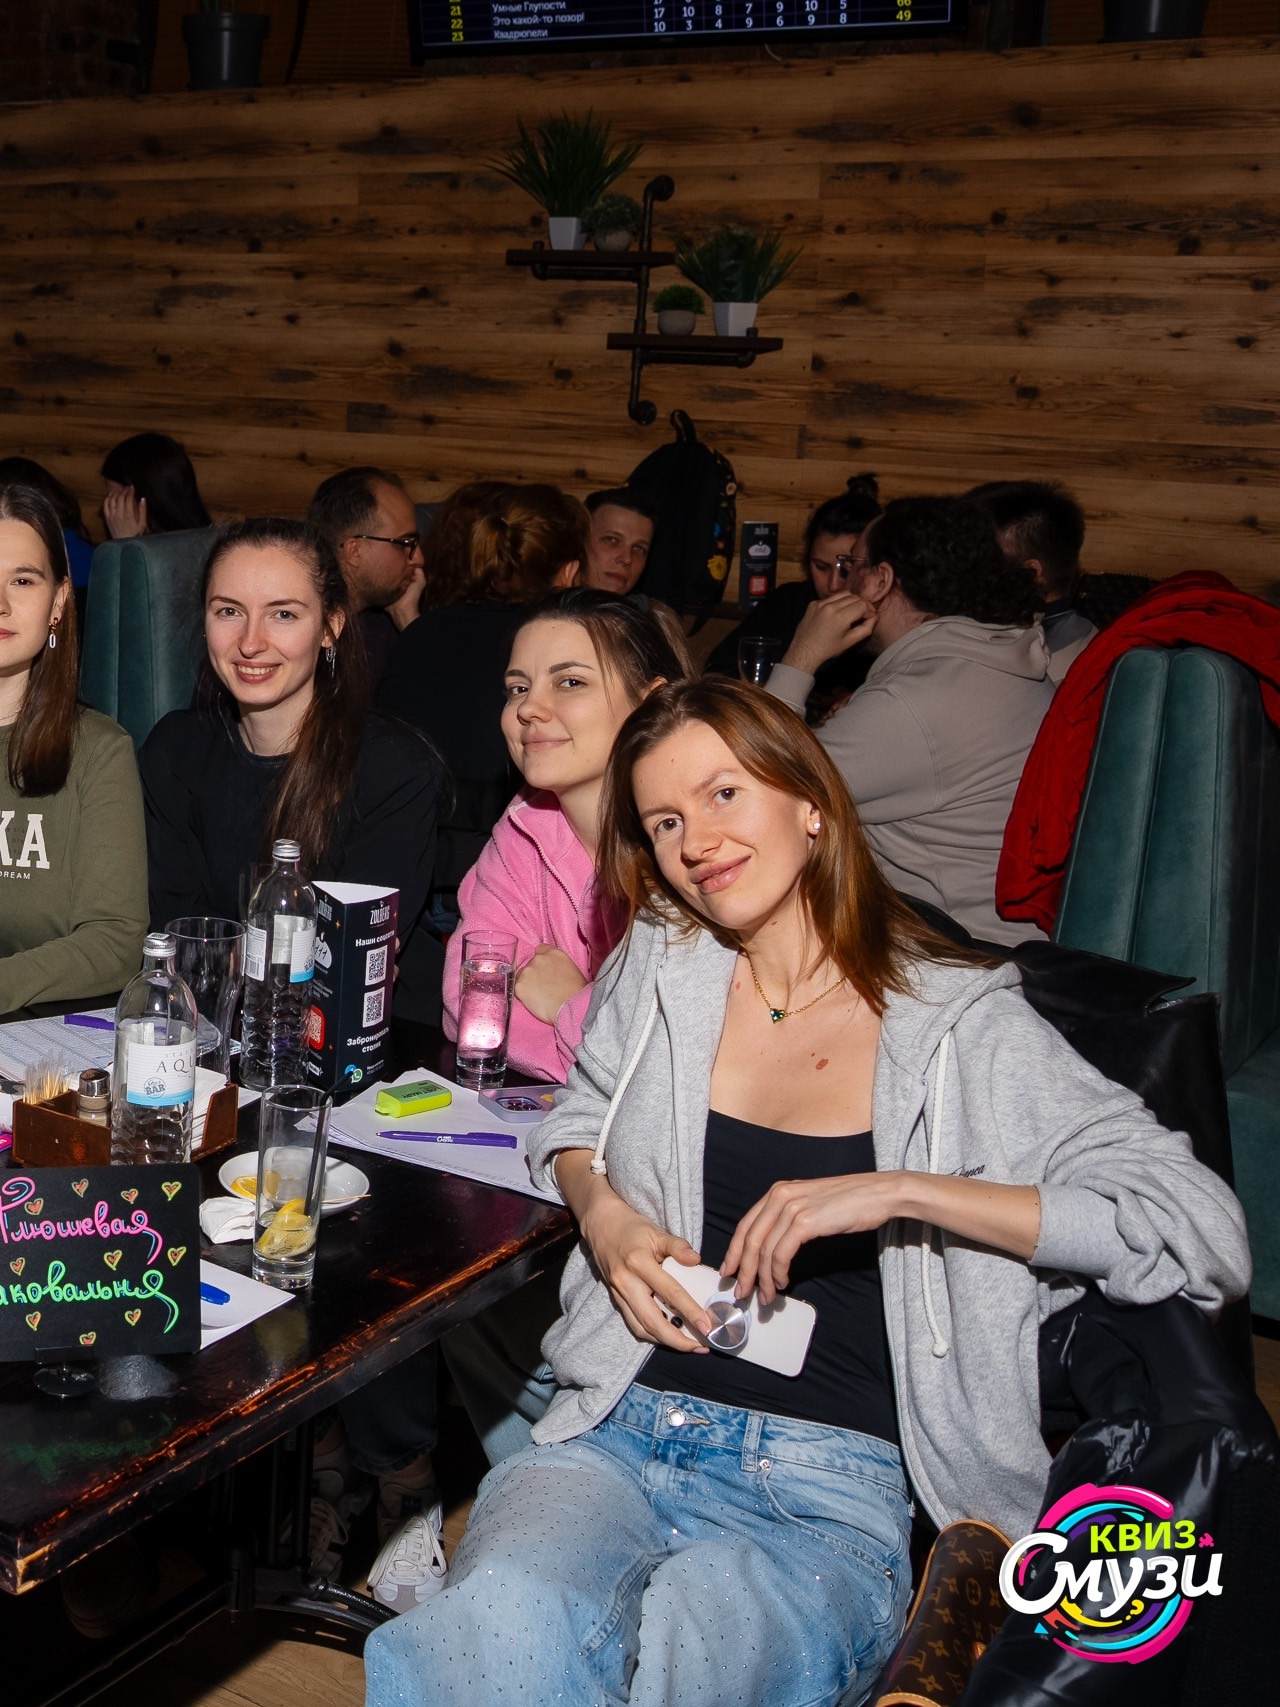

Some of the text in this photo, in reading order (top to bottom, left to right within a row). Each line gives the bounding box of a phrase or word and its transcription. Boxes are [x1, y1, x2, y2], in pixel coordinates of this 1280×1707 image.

[451, 1, 567, 16] 21 Умные Глупости
[451, 19, 463, 29] 22
[493, 16, 511, 26] Это
[512, 14, 553, 25] какой-то
[653, 8, 665, 19] 17
[683, 6, 695, 17] 10
[715, 5, 723, 15] 8
[745, 3, 753, 14] 7
[776, 2, 784, 12] 9
[805, 0, 818, 11] 10
[452, 31, 464, 42] 23
[653, 21, 666, 33] 10
[686, 20, 693, 31] 3
[715, 18, 722, 29] 4
[745, 17, 753, 28] 9
[776, 15, 784, 27] 6
[808, 14, 815, 25] 9
[840, 13, 847, 24] 8
[896, 10, 911, 21] 49
[356, 938, 376, 947] Наши
[145, 1084, 166, 1095] BAR
